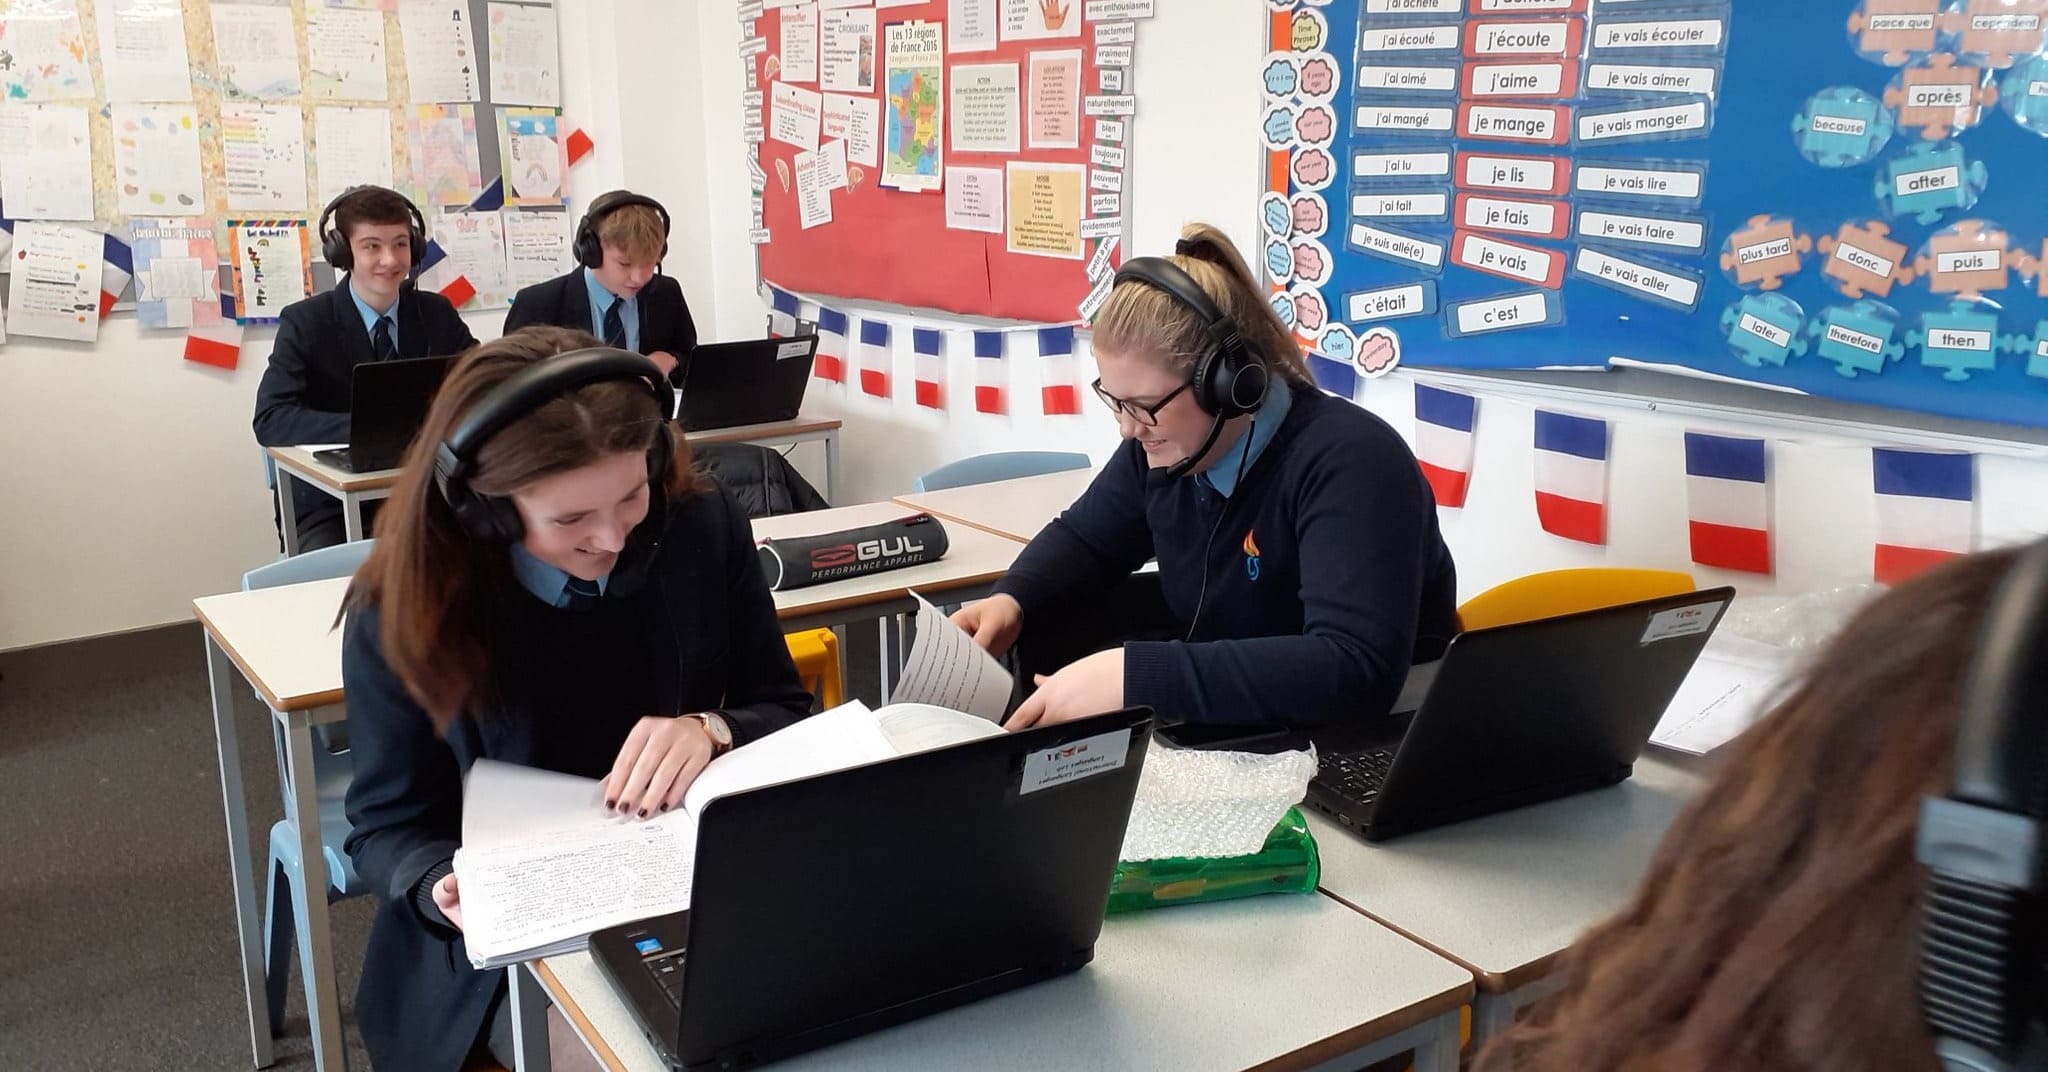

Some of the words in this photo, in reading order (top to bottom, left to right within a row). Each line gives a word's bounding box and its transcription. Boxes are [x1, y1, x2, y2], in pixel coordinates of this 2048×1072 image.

[1104, 1, 1150, 11] enthousiasme
[1097, 26, 1133, 36] exactement
[1872, 20, 1904, 29] parce
[1908, 19, 1930, 30] que
[892, 29, 903, 40] Les
[905, 28, 913, 39] 13
[914, 28, 936, 42] régions
[1382, 34, 1397, 48] j'ai
[1400, 32, 1435, 45] écouté
[1487, 31, 1550, 50] j'écoute
[1607, 30, 1620, 45] je
[1624, 28, 1648, 42] vais
[1651, 27, 1704, 41] écouter
[890, 42, 899, 53] de
[900, 41, 921, 53] France
[923, 40, 938, 52] 2016
[1098, 48, 1129, 58] vraiment
[1103, 73, 1118, 82] vite
[1383, 72, 1399, 86] j'ai
[1401, 72, 1427, 85] aimé
[1490, 72, 1538, 92] j'aime
[1607, 71, 1619, 86] je
[1624, 72, 1648, 86] vais
[1651, 73, 1690, 87] aimer
[1087, 98, 1133, 108] naturellement
[1917, 88, 1962, 106] après
[1376, 112, 1392, 126] j'ai
[1393, 113, 1430, 127] mangé
[1475, 114, 1488, 132] je
[1493, 118, 1545, 136] mange
[1592, 121, 1604, 136] je
[1608, 118, 1632, 131] vais
[1635, 113, 1689, 128] manger
[1814, 118, 1864, 134] because
[1101, 124, 1116, 133] bien
[1094, 148, 1121, 160] toujours
[1385, 160, 1400, 173] j'ai
[1402, 160, 1412, 171] lu
[1094, 174, 1119, 184] souvent
[1492, 166, 1506, 184] je
[1510, 167, 1525, 182] lis
[1604, 174, 1616, 190] je
[1620, 176, 1644, 190] vais
[1647, 177, 1667, 190] lire
[1908, 173, 1946, 191] after
[1093, 196, 1117, 207] parfois
[1379, 200, 1394, 213] j'ai
[1395, 199, 1412, 211] fait
[1485, 207, 1500, 225] je
[1503, 209, 1529, 226] fais
[1082, 219, 1121, 231] évidemment
[1602, 220, 1615, 234] je
[1618, 223, 1642, 236] vais
[1645, 224, 1675, 240] faire
[1363, 232, 1373, 245] je
[1374, 235, 1391, 250] suis
[1392, 239, 1425, 260] allé(e)
[1740, 247, 1764, 265] plus
[1765, 241, 1790, 257] tard
[1479, 246, 1496, 264] je
[1499, 255, 1527, 272] vais
[1847, 250, 1879, 271] donc
[1952, 255, 1984, 272] puis
[1599, 261, 1612, 275] je
[1615, 268, 1638, 283] vais
[1641, 274, 1670, 292] aller
[1364, 294, 1406, 314] c'était
[1483, 304, 1519, 324] c'est
[1751, 320, 1778, 340] later
[1331, 342, 1344, 352] hier
[1830, 328, 1880, 352] therefore
[1942, 334, 1976, 347] then
[857, 536, 924, 560] GUL
[811, 560, 880, 580] PERFORMANCE
[884, 555, 923, 567] APPAREL
